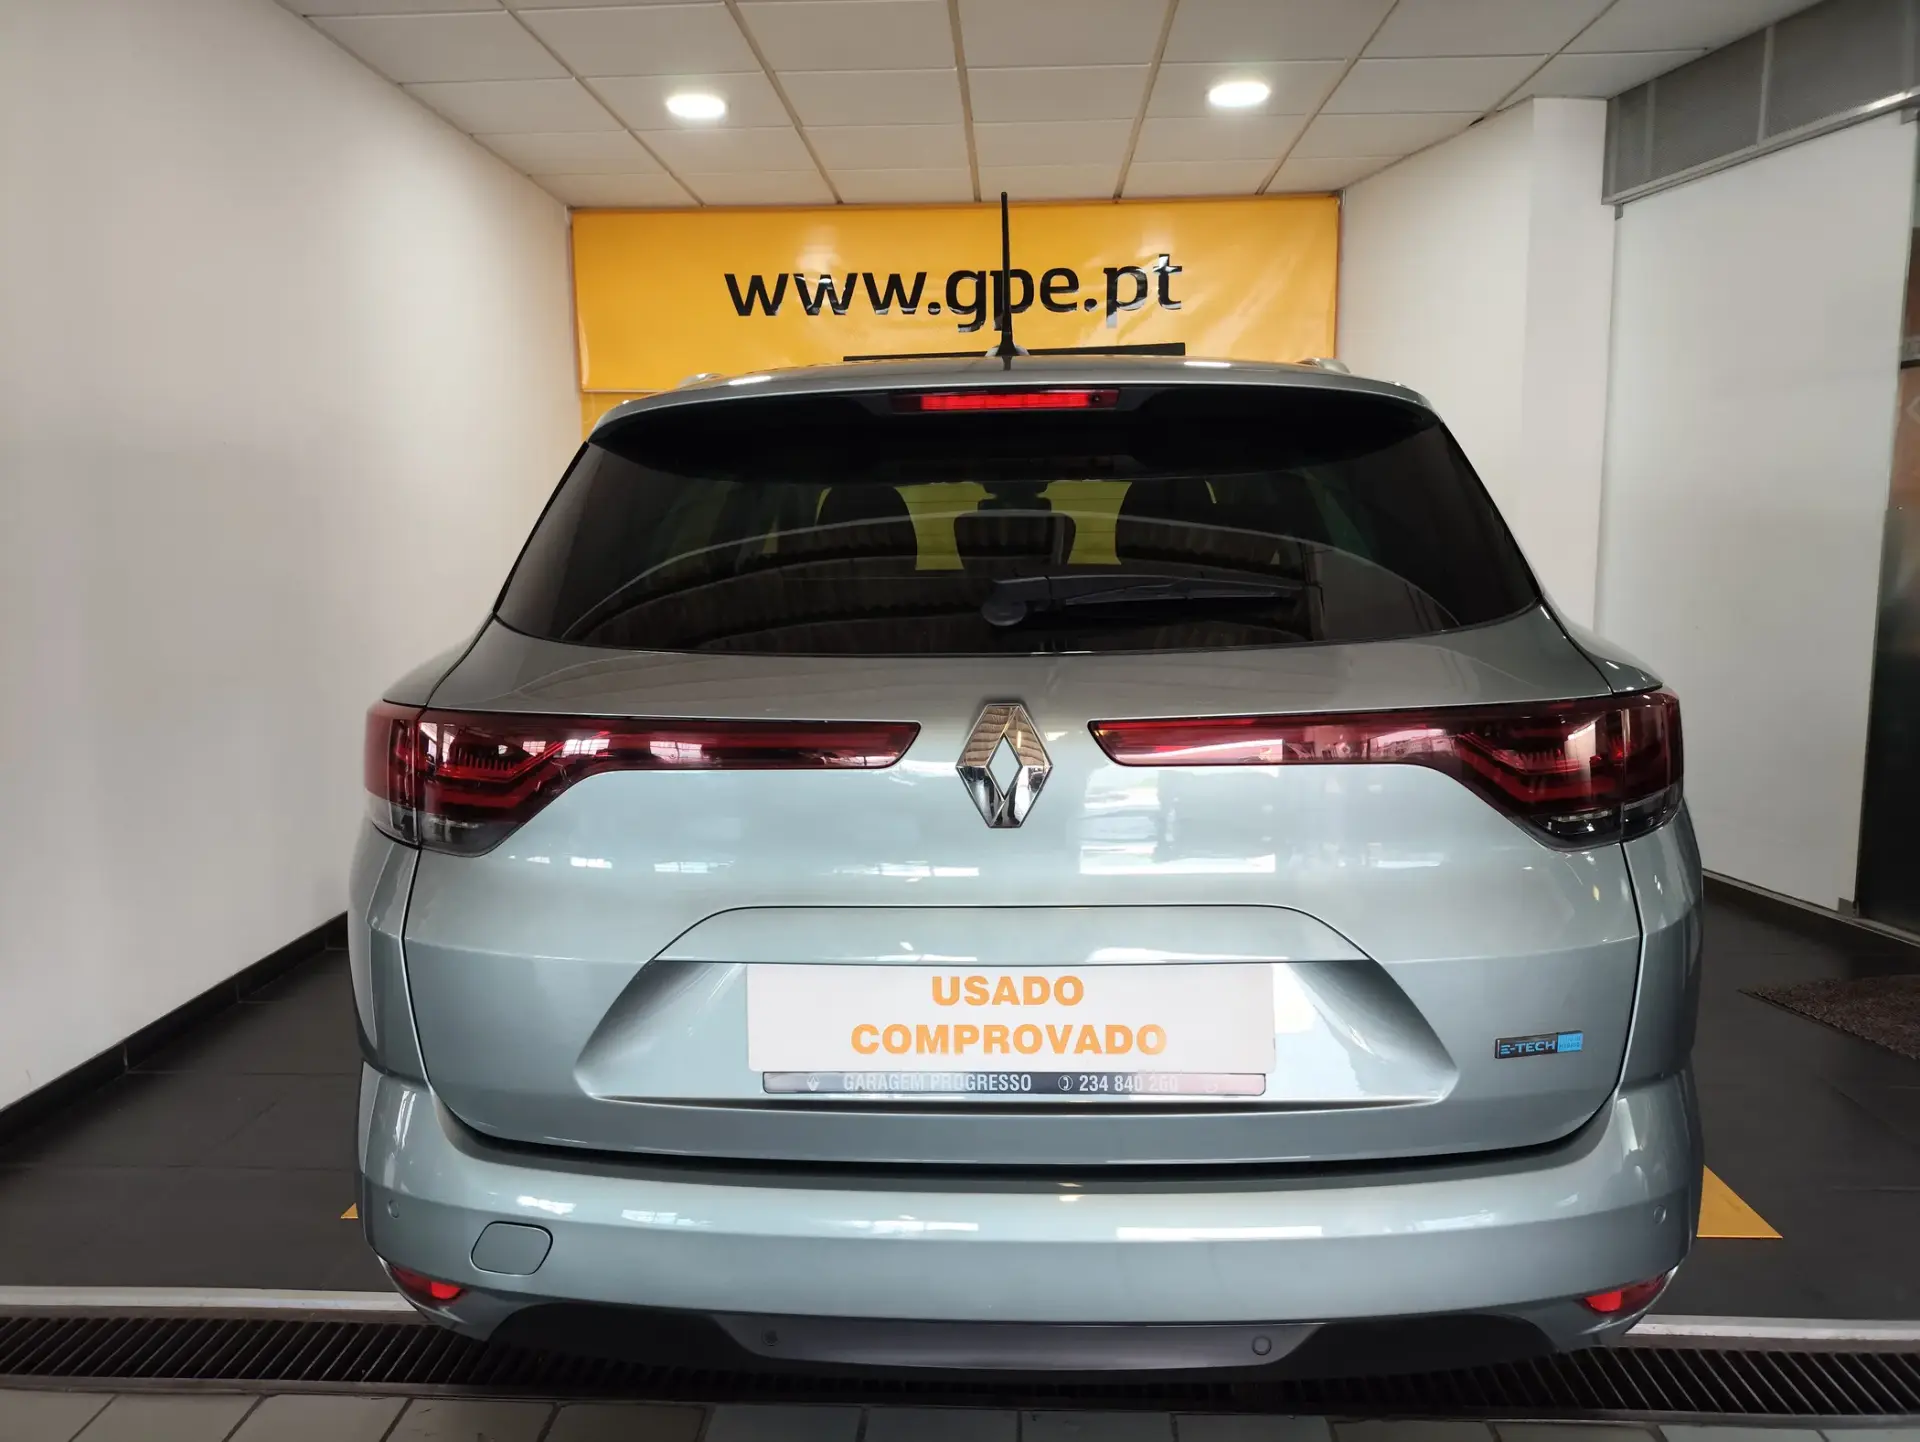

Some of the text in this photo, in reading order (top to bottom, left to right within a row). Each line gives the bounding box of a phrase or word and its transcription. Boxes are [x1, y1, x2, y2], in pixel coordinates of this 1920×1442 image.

[724, 253, 1182, 332] www.gpe.pt
[932, 975, 1085, 1006] USADO
[851, 1023, 1167, 1055] COMPROVADO
[1500, 1040, 1556, 1055] E-TECH
[843, 1074, 924, 1091] GARAGEM
[931, 1074, 1032, 1091] PROGRESSO
[1079, 1075, 1108, 1092] 234
[1114, 1075, 1143, 1092] 840
